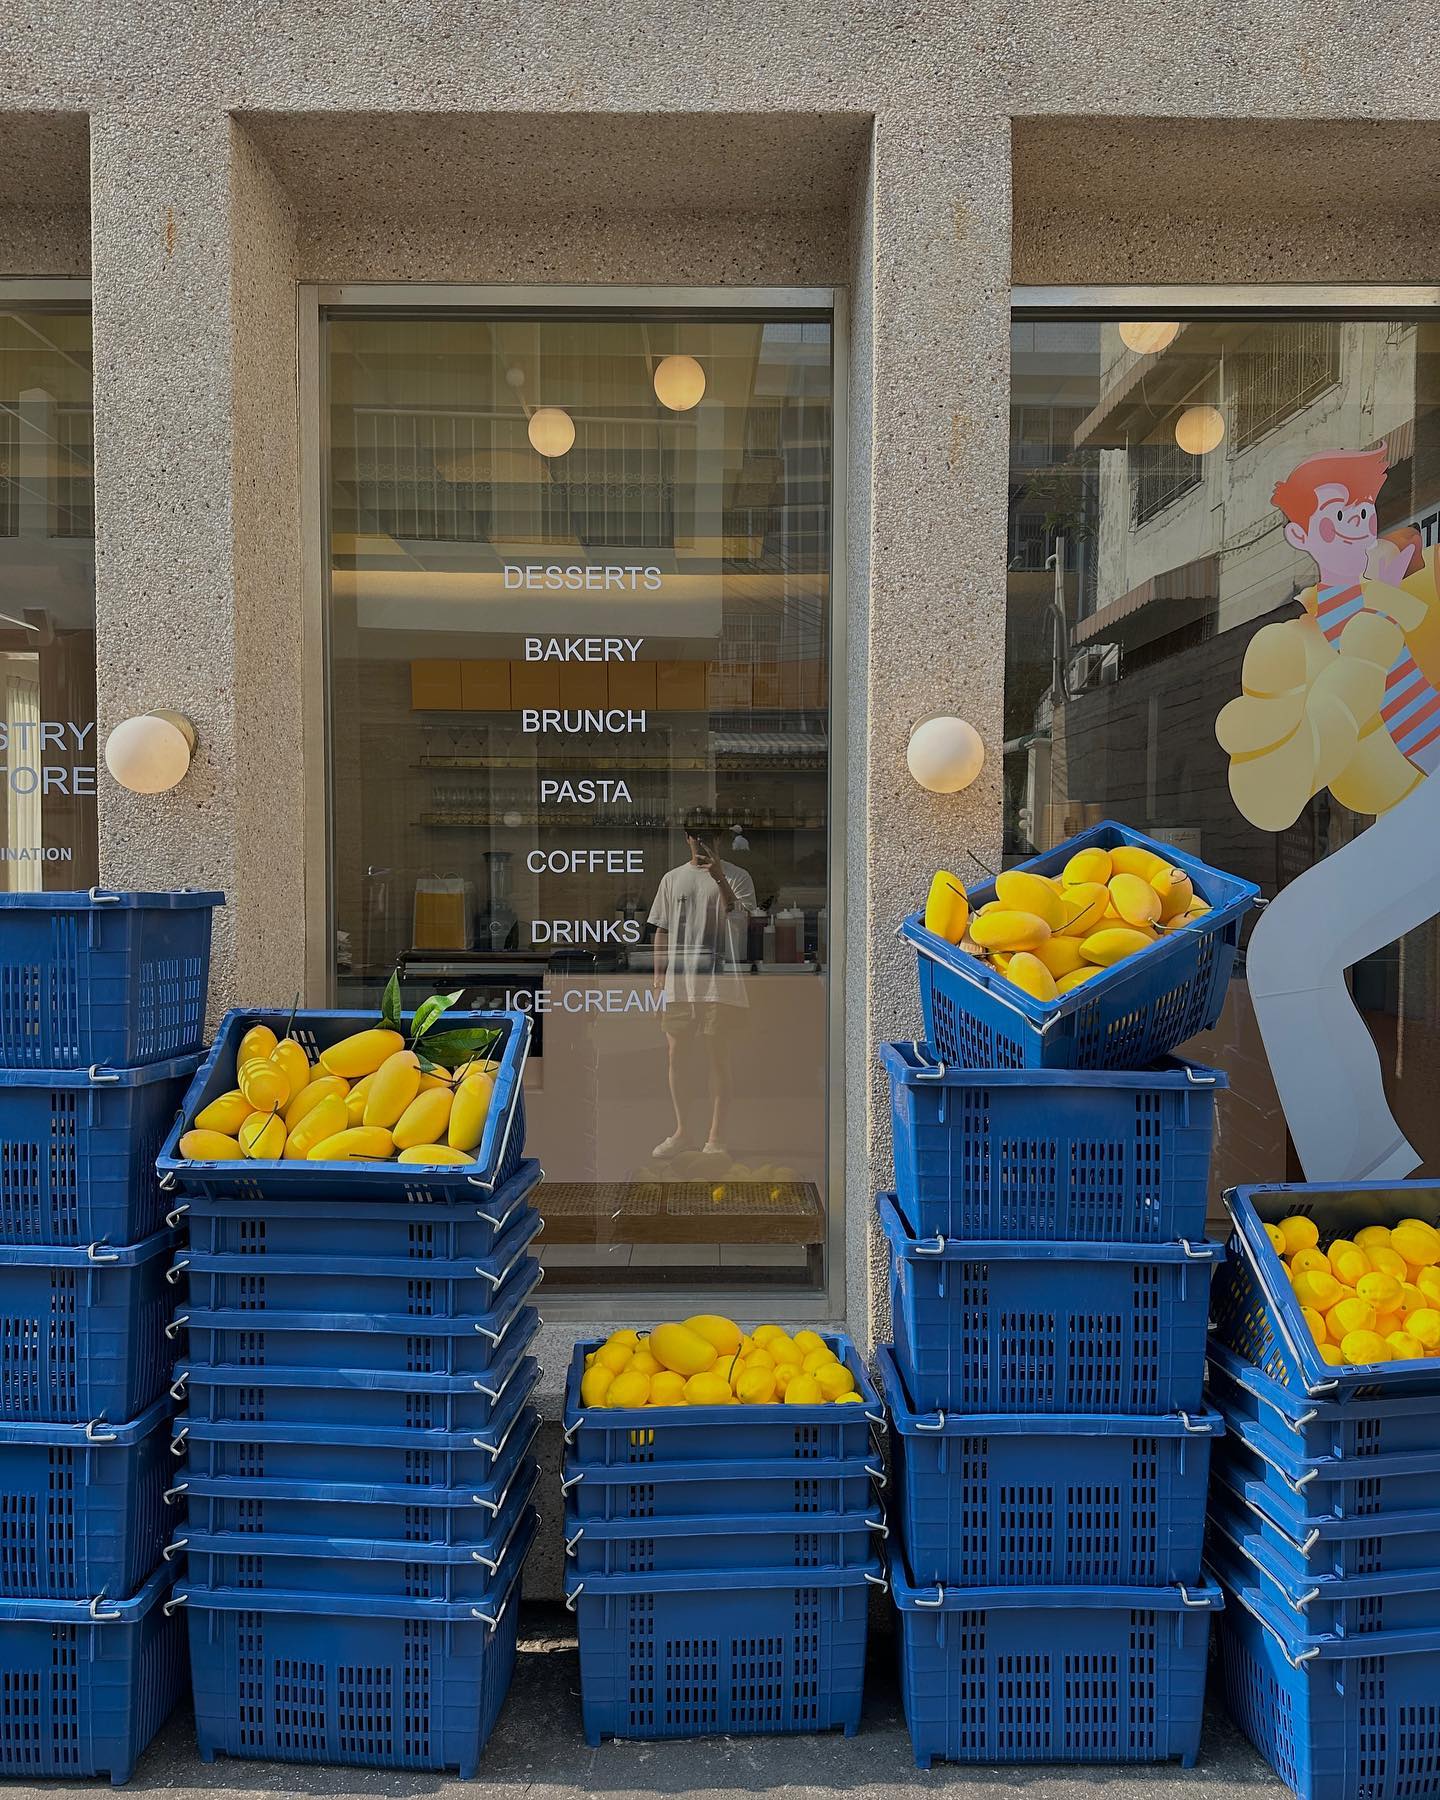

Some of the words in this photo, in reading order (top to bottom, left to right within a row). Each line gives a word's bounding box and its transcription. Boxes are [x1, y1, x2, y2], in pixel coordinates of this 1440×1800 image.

[503, 565, 663, 590] DESSERTS
[525, 637, 644, 662] BAKERY
[522, 709, 647, 733] BRUNCH
[541, 780, 633, 803] PASTA
[1, 847, 72, 861] INATION
[526, 850, 645, 874] COFFEE
[531, 919, 641, 944] DRINKS
[505, 989, 668, 1013] ICE-CREAM
